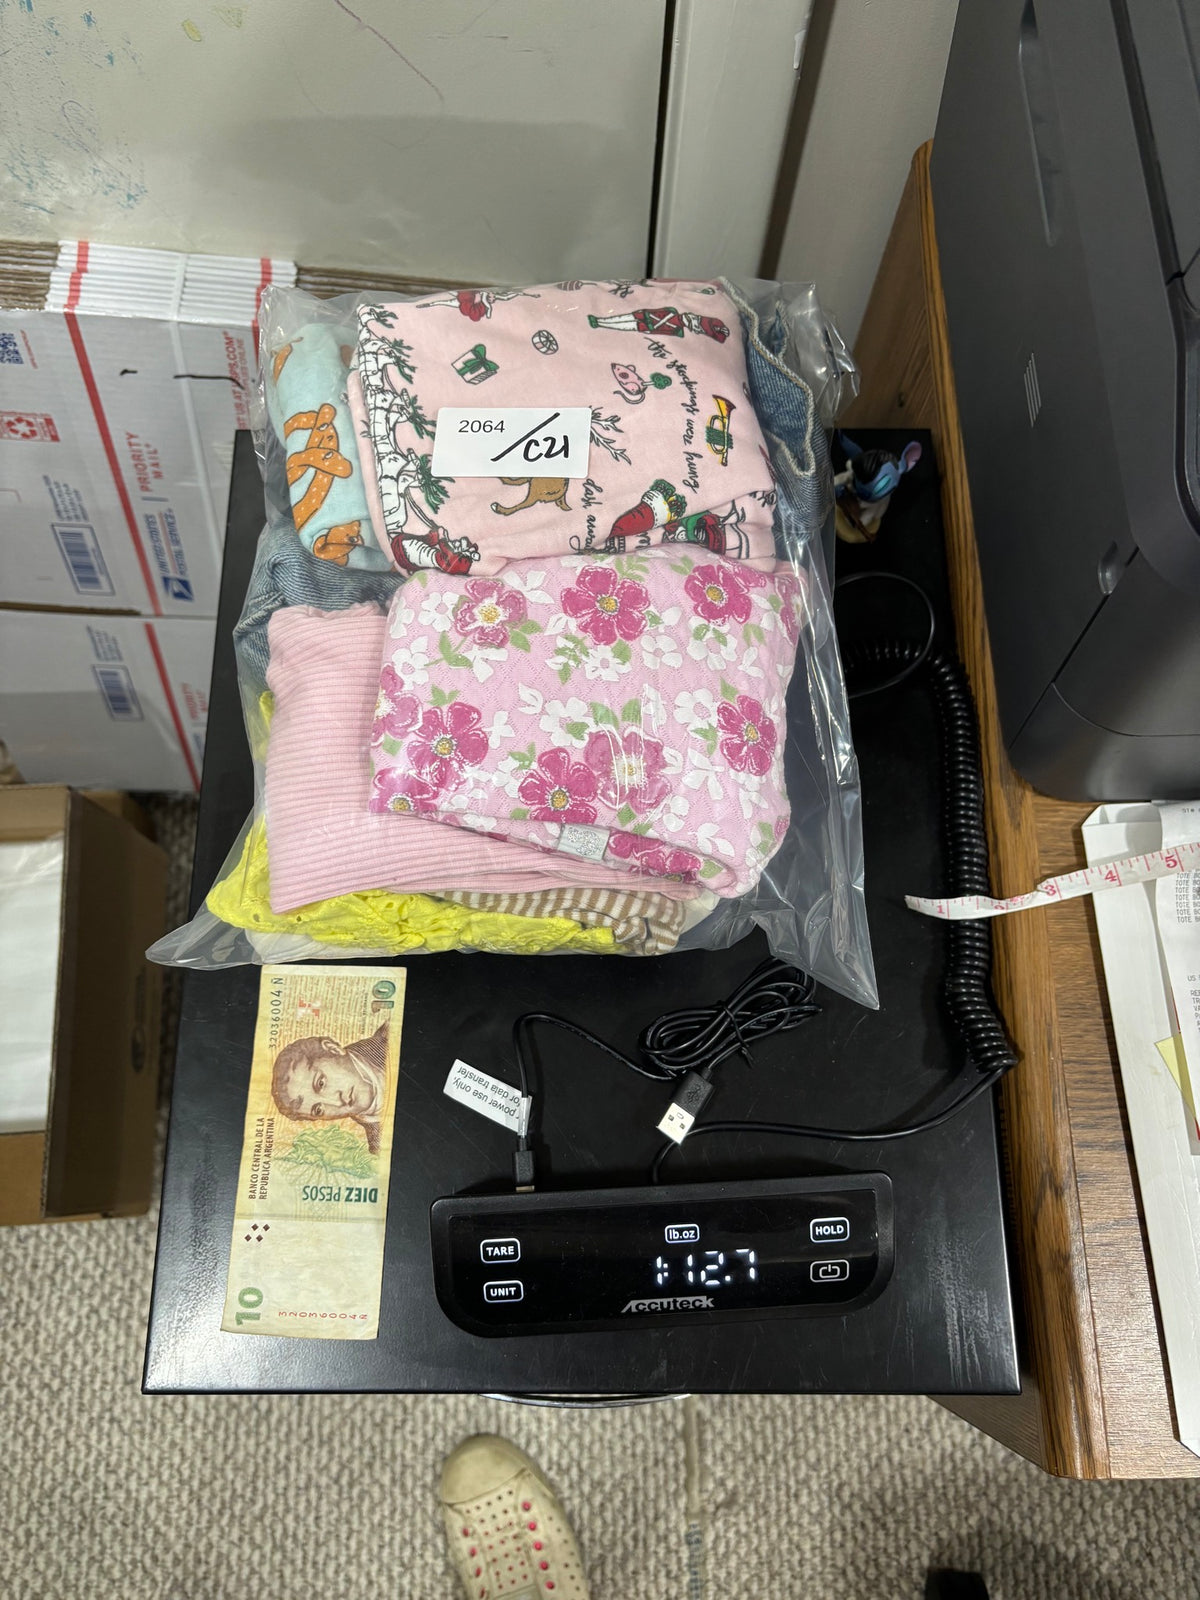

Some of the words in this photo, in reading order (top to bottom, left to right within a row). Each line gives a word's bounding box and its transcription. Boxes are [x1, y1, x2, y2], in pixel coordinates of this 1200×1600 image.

[644, 336, 672, 359] the
[666, 359, 700, 415] stockings
[458, 419, 506, 433] 2064
[682, 418, 696, 446] were
[126, 432, 153, 493] PRIORITY
[682, 451, 703, 494] hung
[581, 478, 603, 509] dash
[1165, 855, 1178, 868] 5
[1104, 870, 1118, 882] 4
[1044, 884, 1057, 896] 3
[937, 905, 945, 915] 1
[371, 980, 396, 1014] 10
[269, 989, 282, 1049] 32036004
[453, 1077, 472, 1093] only,
[457, 1066, 490, 1089] transfer
[472, 1089, 489, 1103] use
[490, 1084, 509, 1099] data
[488, 1100, 517, 1117] power
[256, 1117, 265, 1127] LA
[255, 1128, 264, 1138] DE
[264, 1117, 275, 1159] ARGENTINA
[252, 1139, 263, 1172] CENTRAL
[249, 1174, 259, 1199] BANCO
[259, 1160, 272, 1200] REPUBLICA
[302, 1185, 341, 1201] PESOS
[345, 1187, 378, 1203] DIEZ
[668, 1227, 696, 1240] lb.oz
[815, 1225, 845, 1236] HOLD
[485, 1246, 515, 1256] TARE
[490, 1287, 516, 1297] UNIT
[235, 1287, 264, 1326] 10
